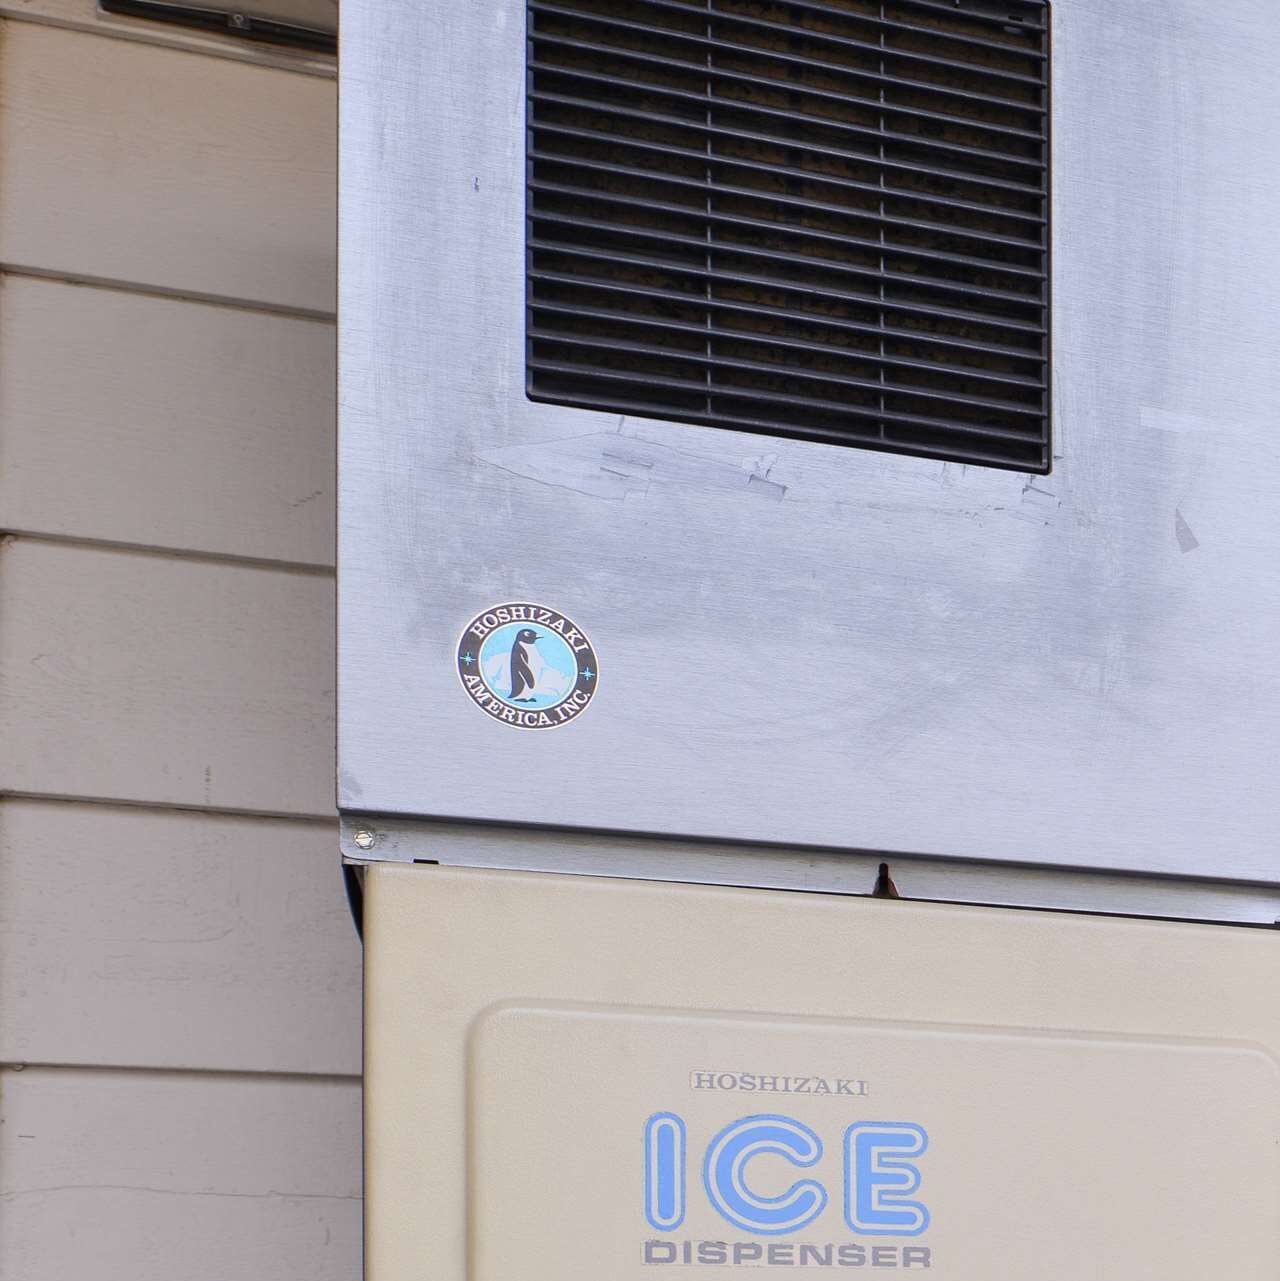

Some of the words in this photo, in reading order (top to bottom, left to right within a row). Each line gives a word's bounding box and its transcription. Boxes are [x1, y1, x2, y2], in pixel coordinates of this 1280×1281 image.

[469, 606, 590, 653] HOSHIZAKI
[554, 689, 591, 721] INC.
[694, 1072, 868, 1097] HOSHIZAKI
[643, 1111, 931, 1236] ICE
[643, 1241, 932, 1269] DISPENSER
